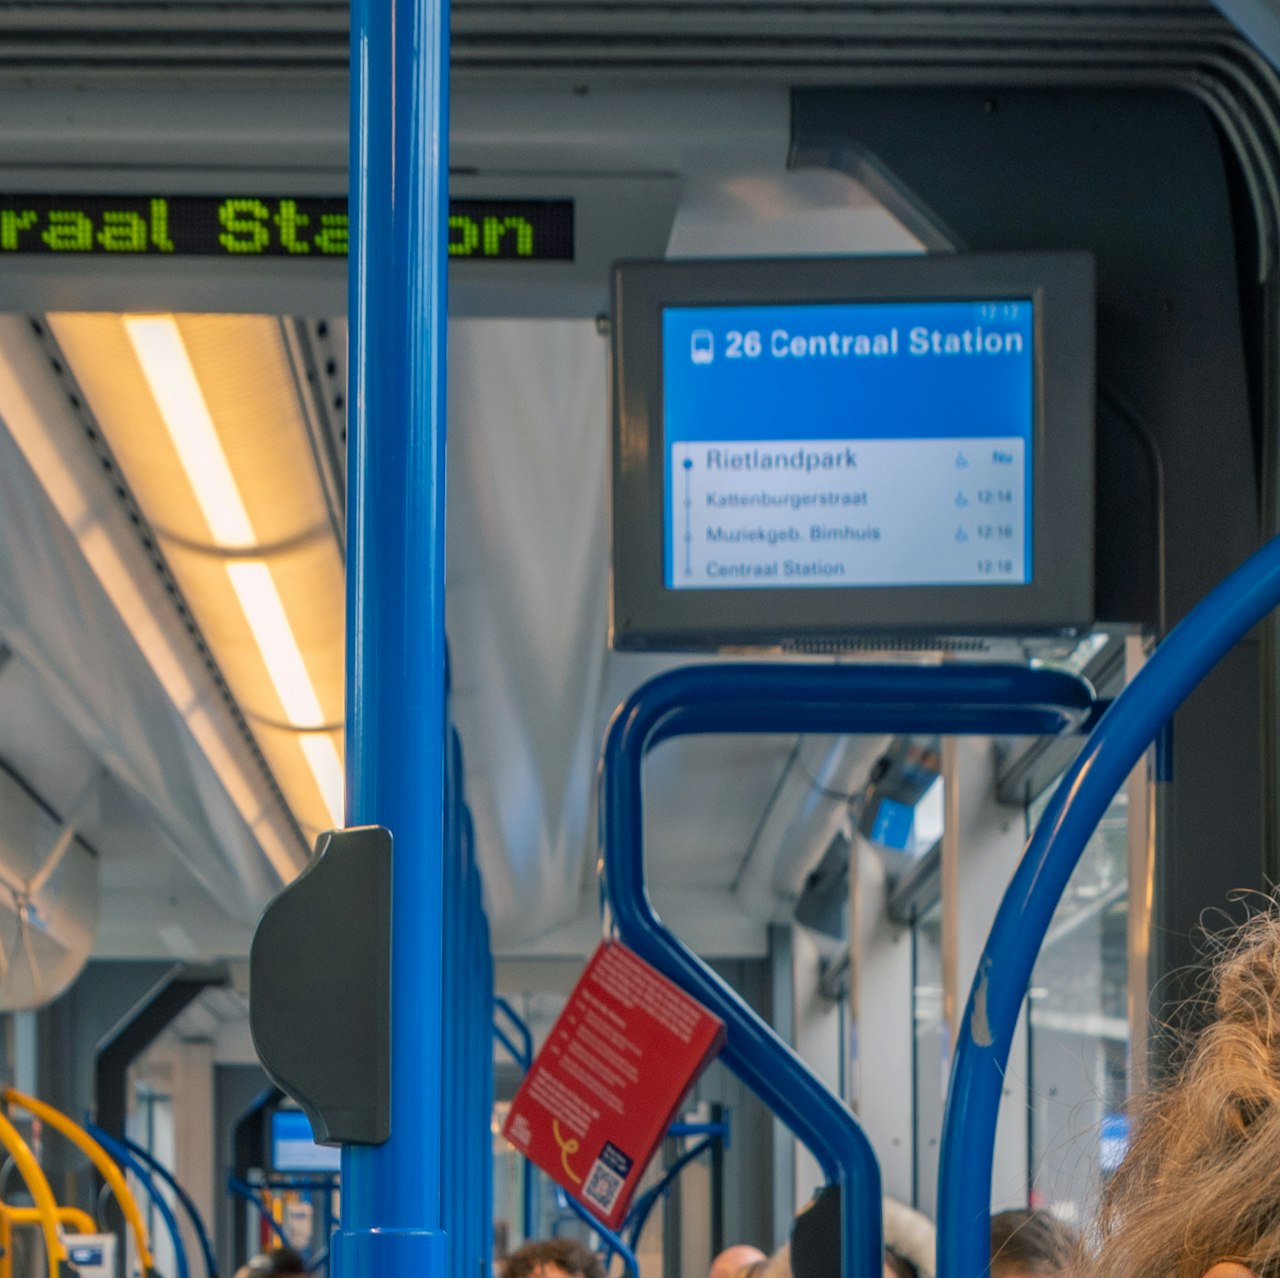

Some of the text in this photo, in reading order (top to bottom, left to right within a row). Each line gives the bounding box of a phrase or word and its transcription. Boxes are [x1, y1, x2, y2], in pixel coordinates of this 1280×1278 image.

[218, 198, 534, 255] Staon
[724, 325, 1024, 358] 26 Centraal Station
[706, 447, 858, 473] Rietlandpark
[706, 490, 869, 510] Kattenburgerstraat
[809, 524, 882, 541] Bimhuis
[706, 558, 846, 577] Centraal Station
